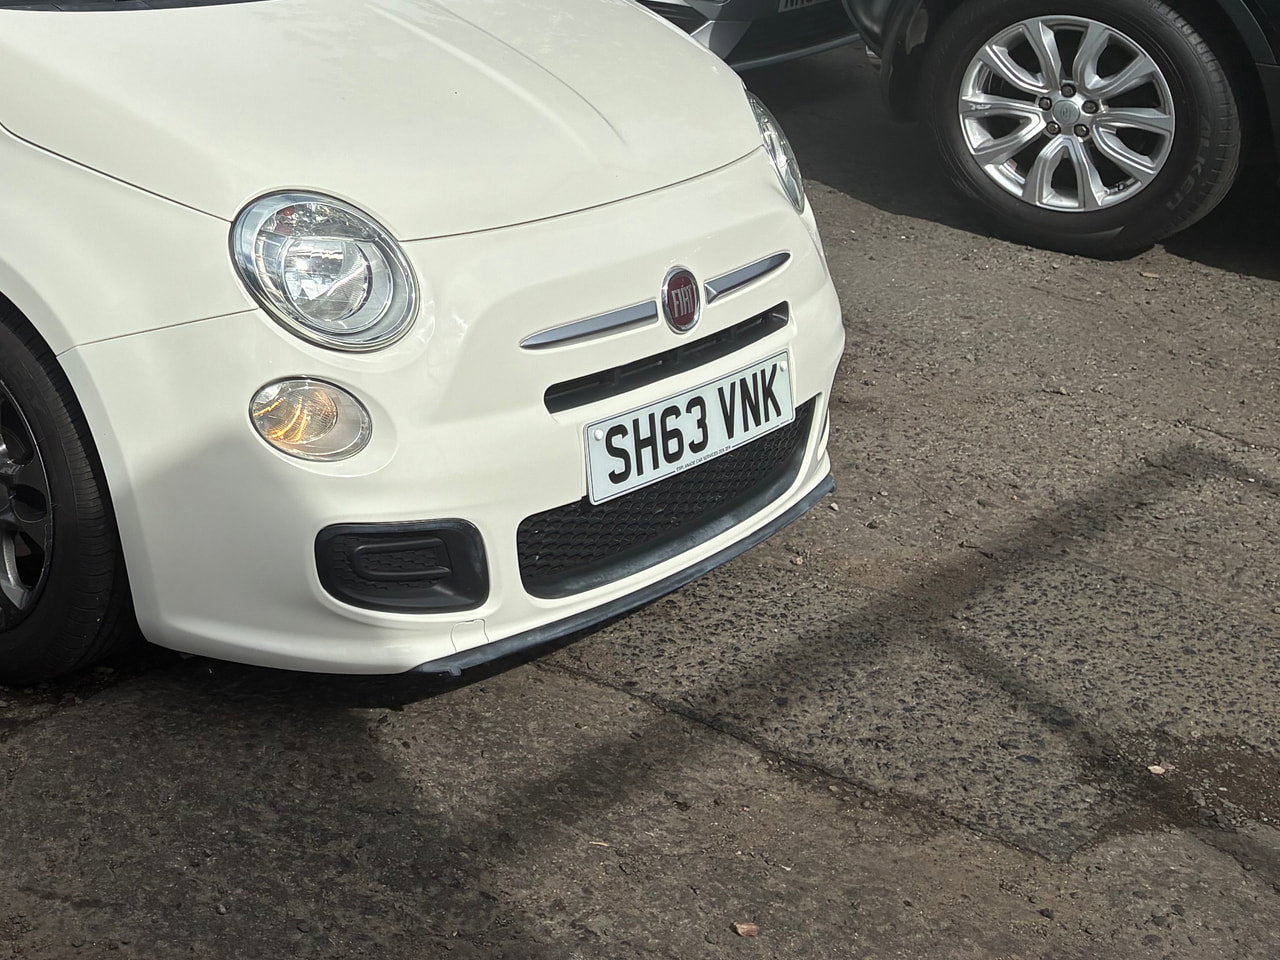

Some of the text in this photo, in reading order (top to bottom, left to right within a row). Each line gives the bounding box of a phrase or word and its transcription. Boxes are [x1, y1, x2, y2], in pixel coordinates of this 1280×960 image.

[671, 284, 696, 318] FIAT
[605, 363, 782, 486] SH63 VNK
